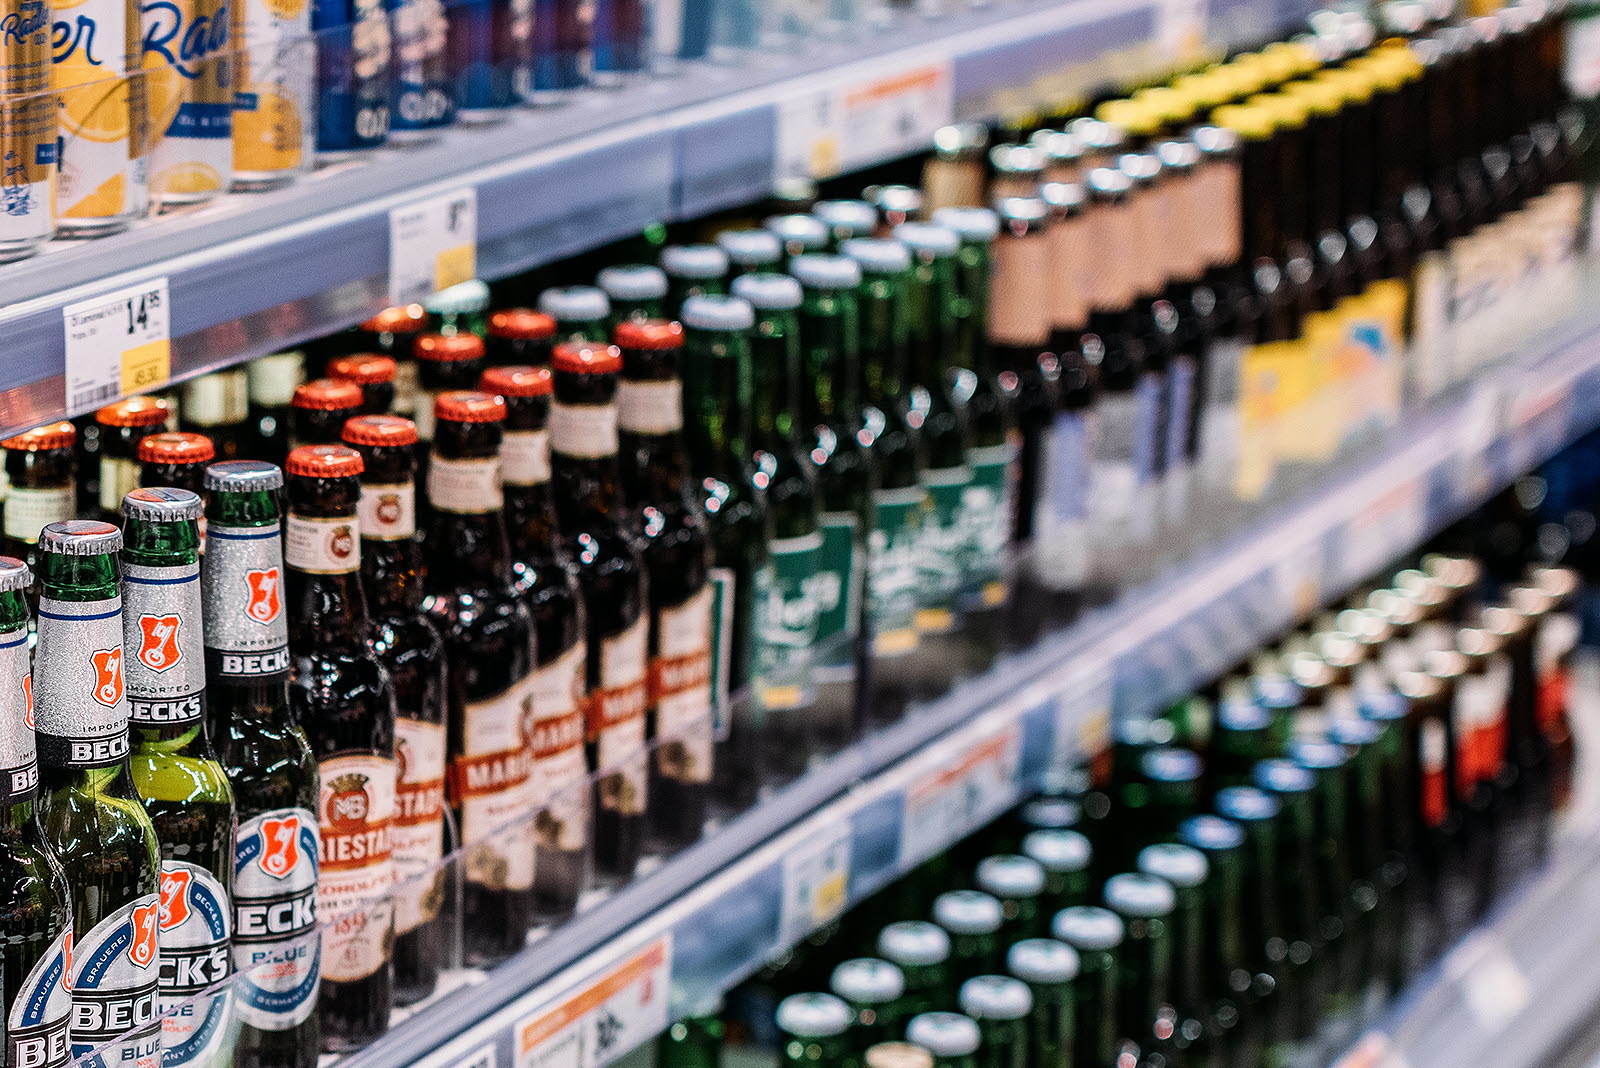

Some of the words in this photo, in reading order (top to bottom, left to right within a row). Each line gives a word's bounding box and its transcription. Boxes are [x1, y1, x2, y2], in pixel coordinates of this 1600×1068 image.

[83, 717, 127, 733] IMPORTE
[237, 898, 317, 937] ECK
[86, 934, 128, 984] BRAUEREI
[30, 964, 61, 1020] BRAUEREI
[121, 1038, 160, 1062] BLUE
